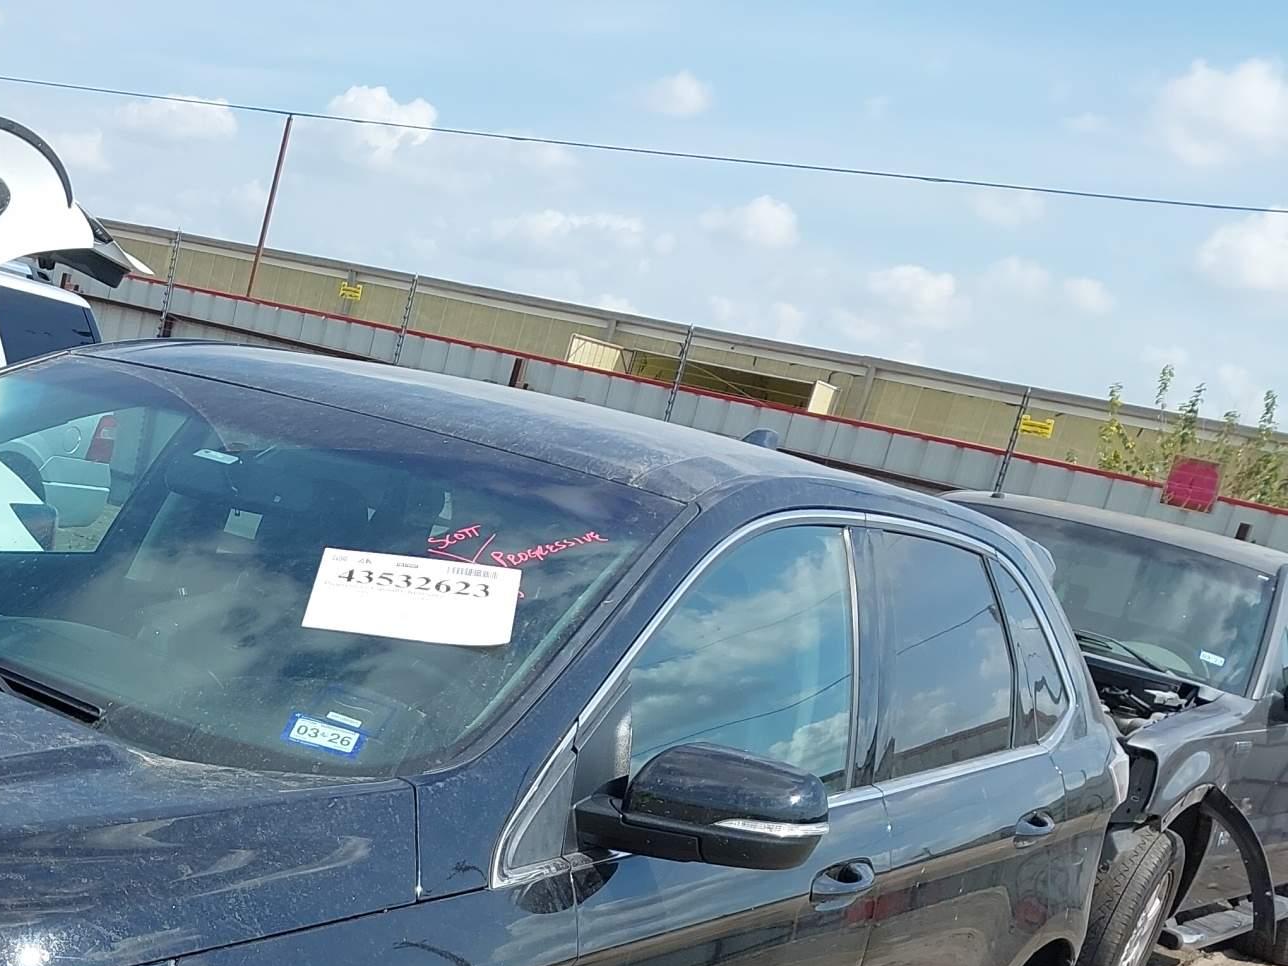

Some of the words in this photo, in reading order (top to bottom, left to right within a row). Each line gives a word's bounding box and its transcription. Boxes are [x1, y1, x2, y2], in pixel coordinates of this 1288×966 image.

[427, 524, 481, 549] SCOTT
[490, 530, 608, 567] PROGRESSIVE
[337, 568, 491, 599] 43532623
